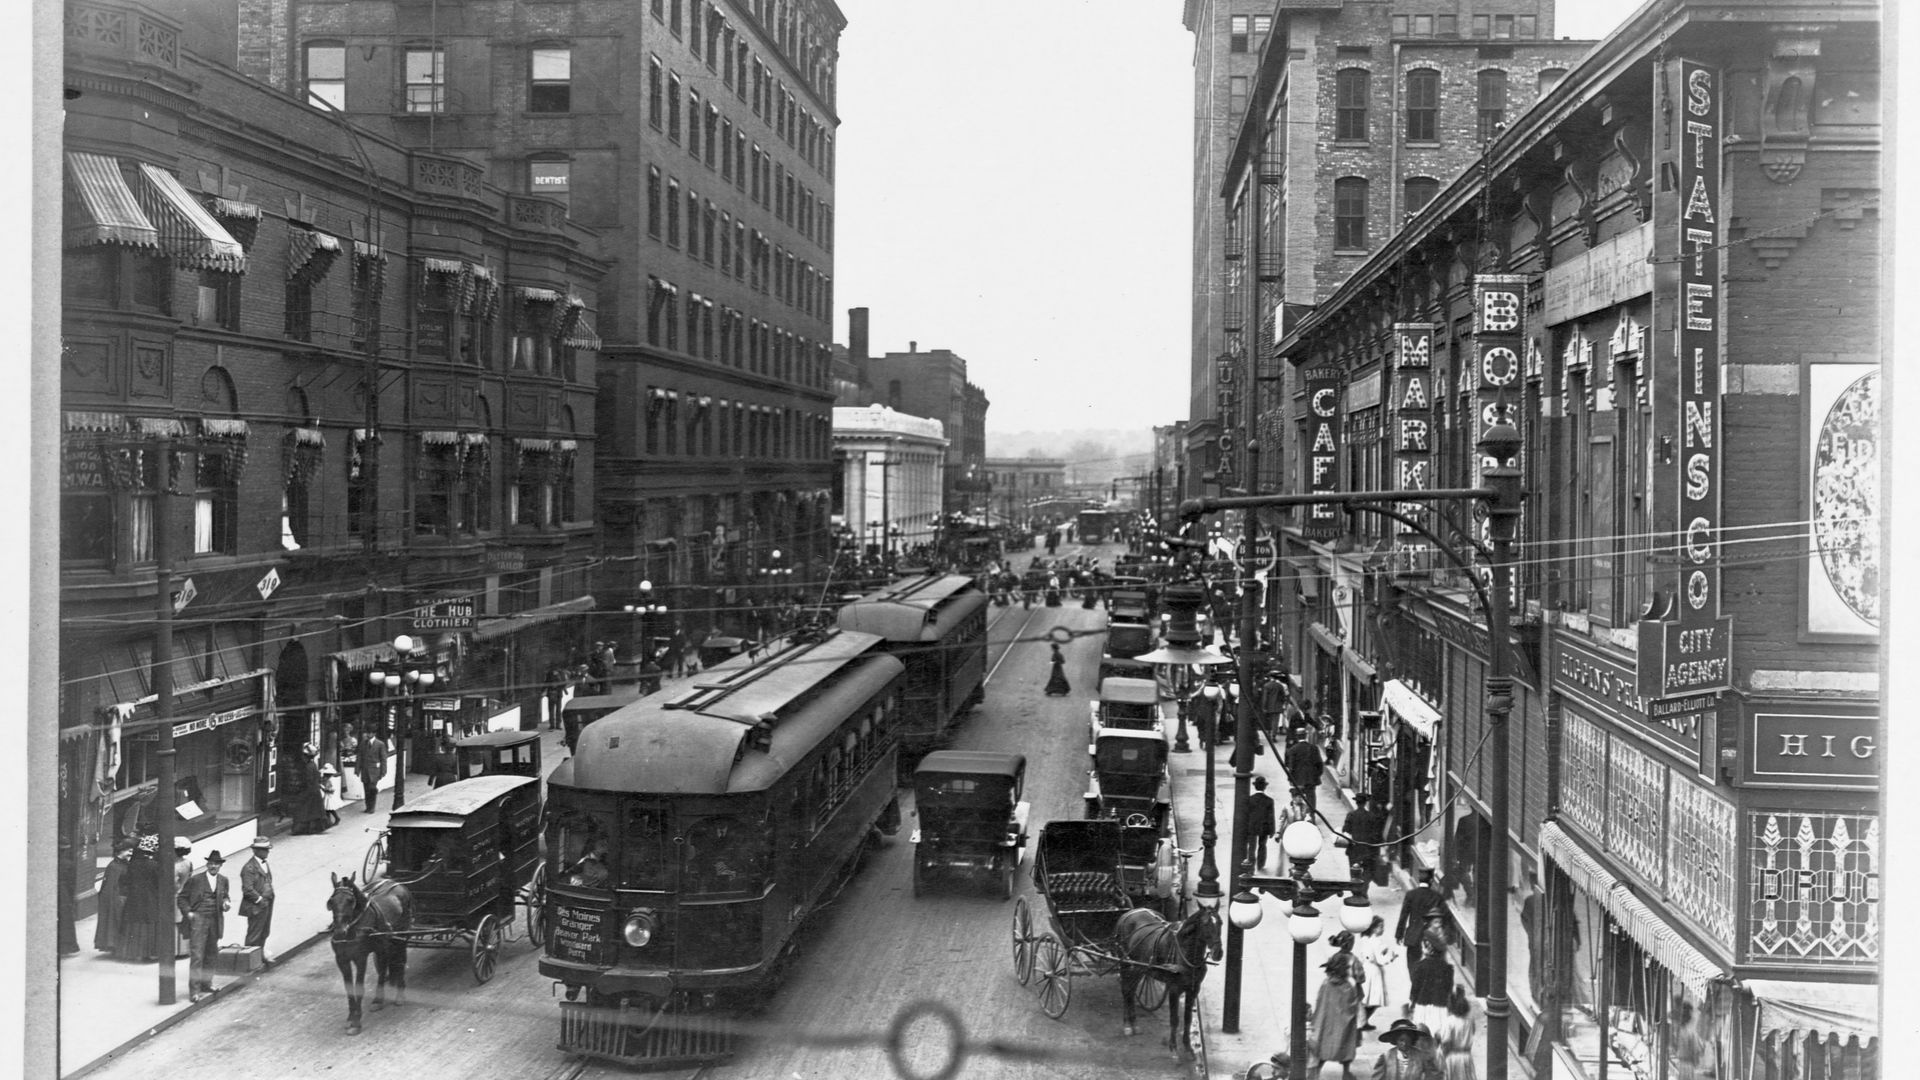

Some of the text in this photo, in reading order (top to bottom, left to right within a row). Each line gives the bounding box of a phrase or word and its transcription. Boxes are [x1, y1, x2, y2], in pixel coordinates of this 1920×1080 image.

[1684, 69, 1714, 331] STATE
[1305, 368, 1342, 381] BAKERY
[1218, 366, 1233, 473] UTICA
[1304, 526, 1341, 538] BAKERY
[1240, 545, 1271, 555] BTON
[260, 577, 278, 592] 319
[414, 605, 472, 617] THE HUB
[1680, 628, 1715, 653] CITY
[1666, 657, 1727, 688] AGENCY
[1779, 733, 1877, 759] HIG
[572, 909, 600, 923] Moines
[561, 917, 595, 931] Granger
[582, 931, 600, 943] Park
